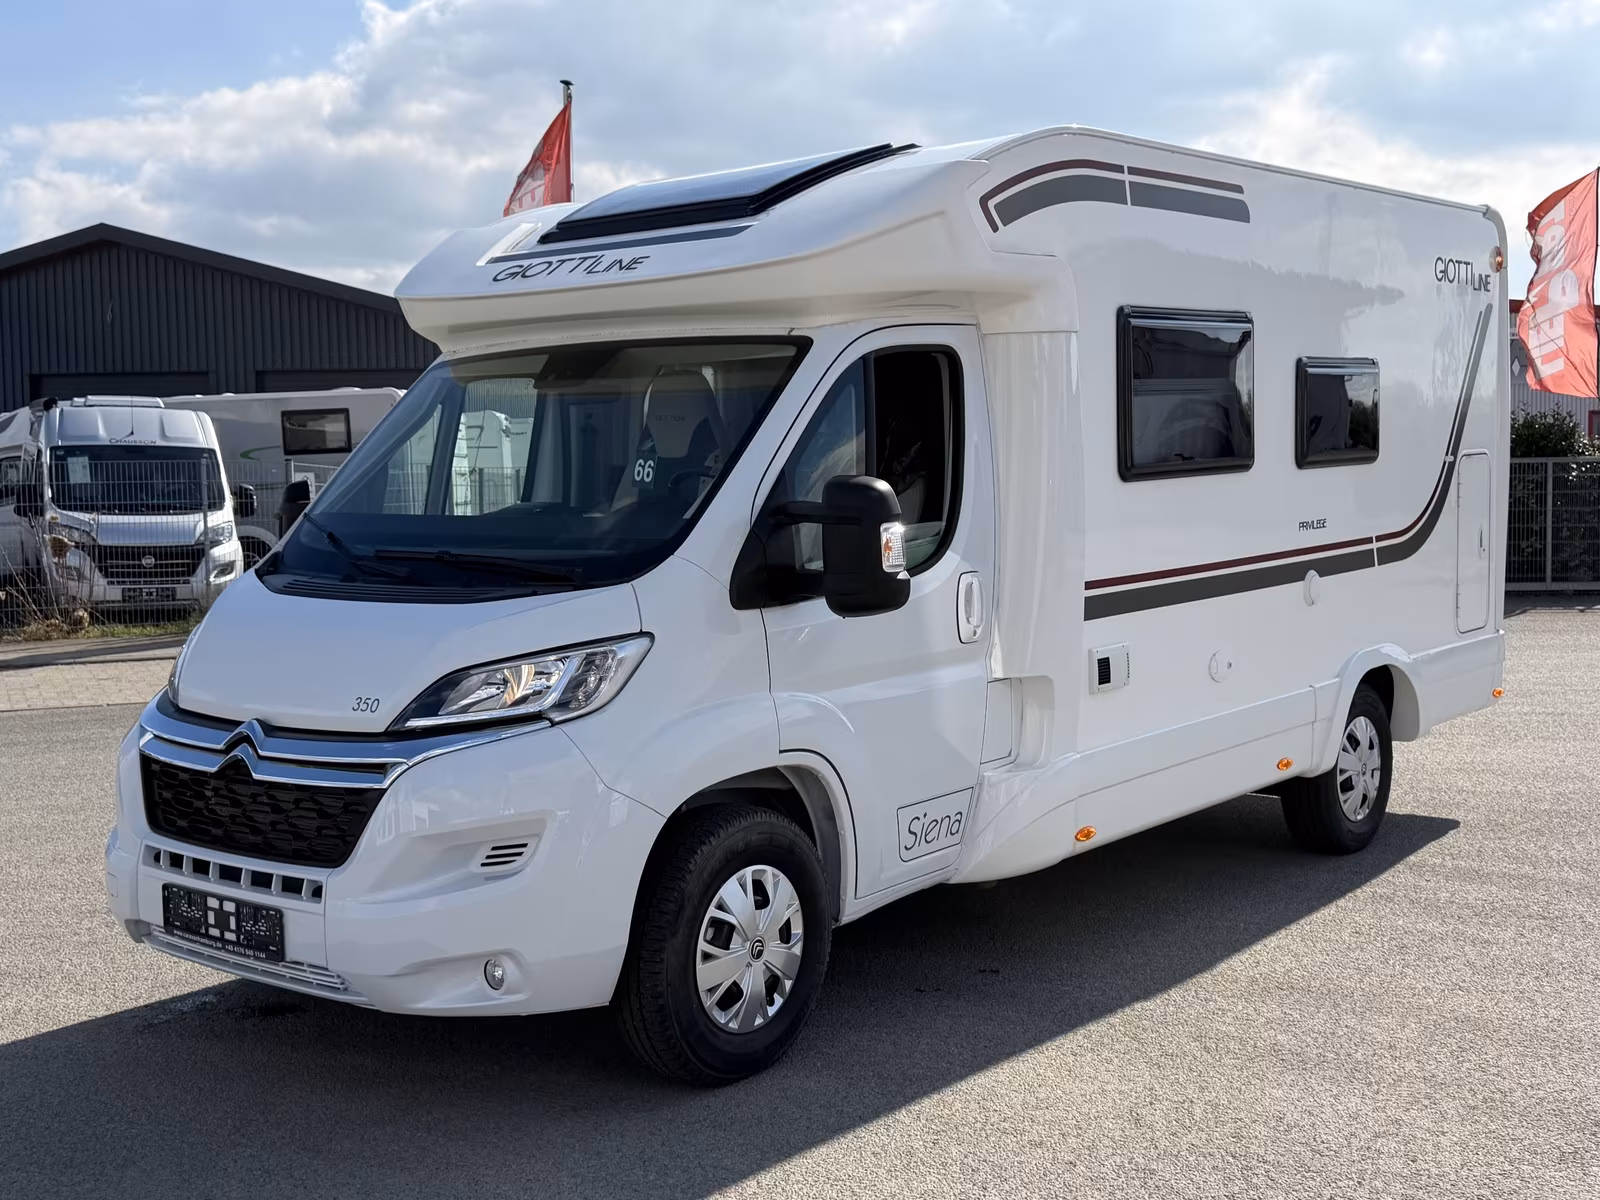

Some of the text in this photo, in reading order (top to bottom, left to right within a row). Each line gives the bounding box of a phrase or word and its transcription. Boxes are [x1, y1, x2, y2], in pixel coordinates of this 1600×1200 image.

[634, 459, 654, 482] 66
[1298, 518, 1328, 532] PRIVILEGE
[352, 696, 380, 713] 350
[904, 811, 963, 851] Siena
